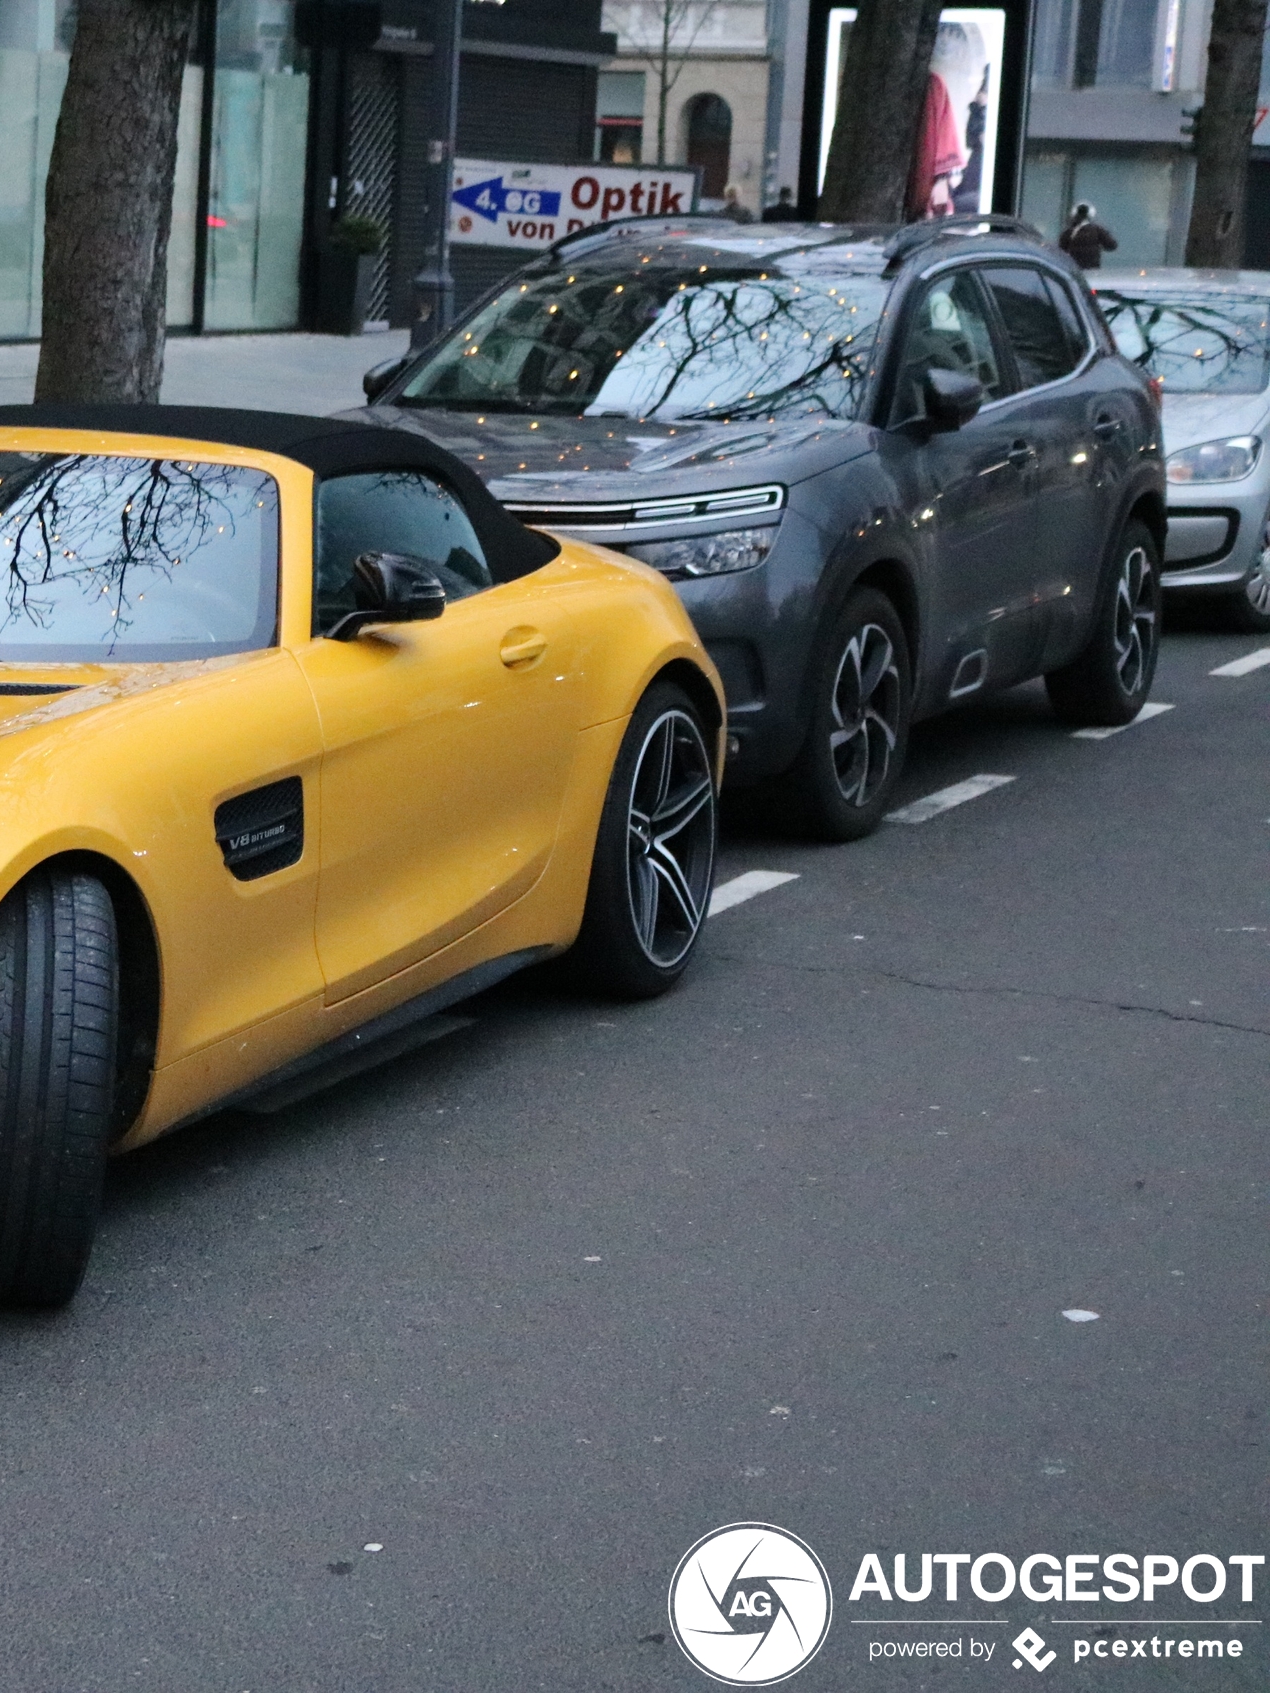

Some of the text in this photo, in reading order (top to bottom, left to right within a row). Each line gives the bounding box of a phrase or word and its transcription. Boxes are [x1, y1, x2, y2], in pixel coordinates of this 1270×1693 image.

[475, 188, 541, 214] 4. OG
[571, 176, 685, 221] Optik
[507, 220, 555, 240] von
[230, 824, 285, 850] V8 BITURBO
